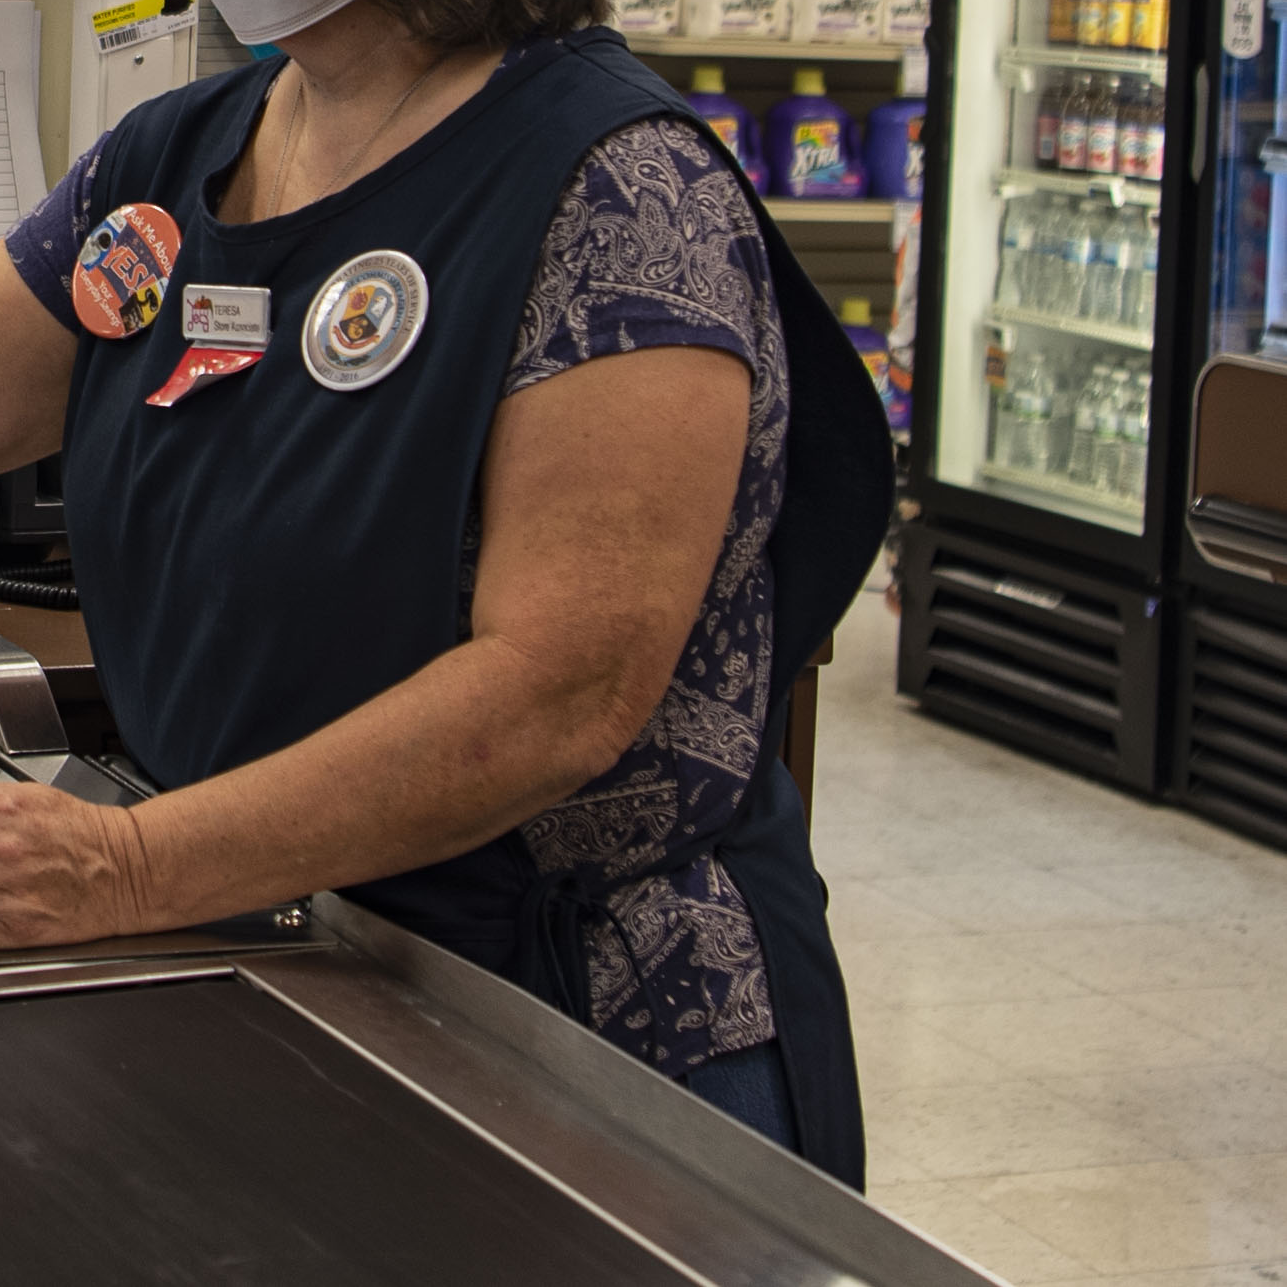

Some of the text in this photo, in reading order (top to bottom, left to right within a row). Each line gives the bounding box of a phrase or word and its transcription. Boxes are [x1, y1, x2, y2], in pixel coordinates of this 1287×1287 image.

[92, 8, 112, 21] WATER
[128, 209, 145, 230] Ask
[142, 223, 156, 244] Me
[101, 240, 158, 297] YES!
[79, 269, 122, 328] Everyday Savings
[99, 280, 114, 300] Your
[214, 305, 242, 316] TERESA
